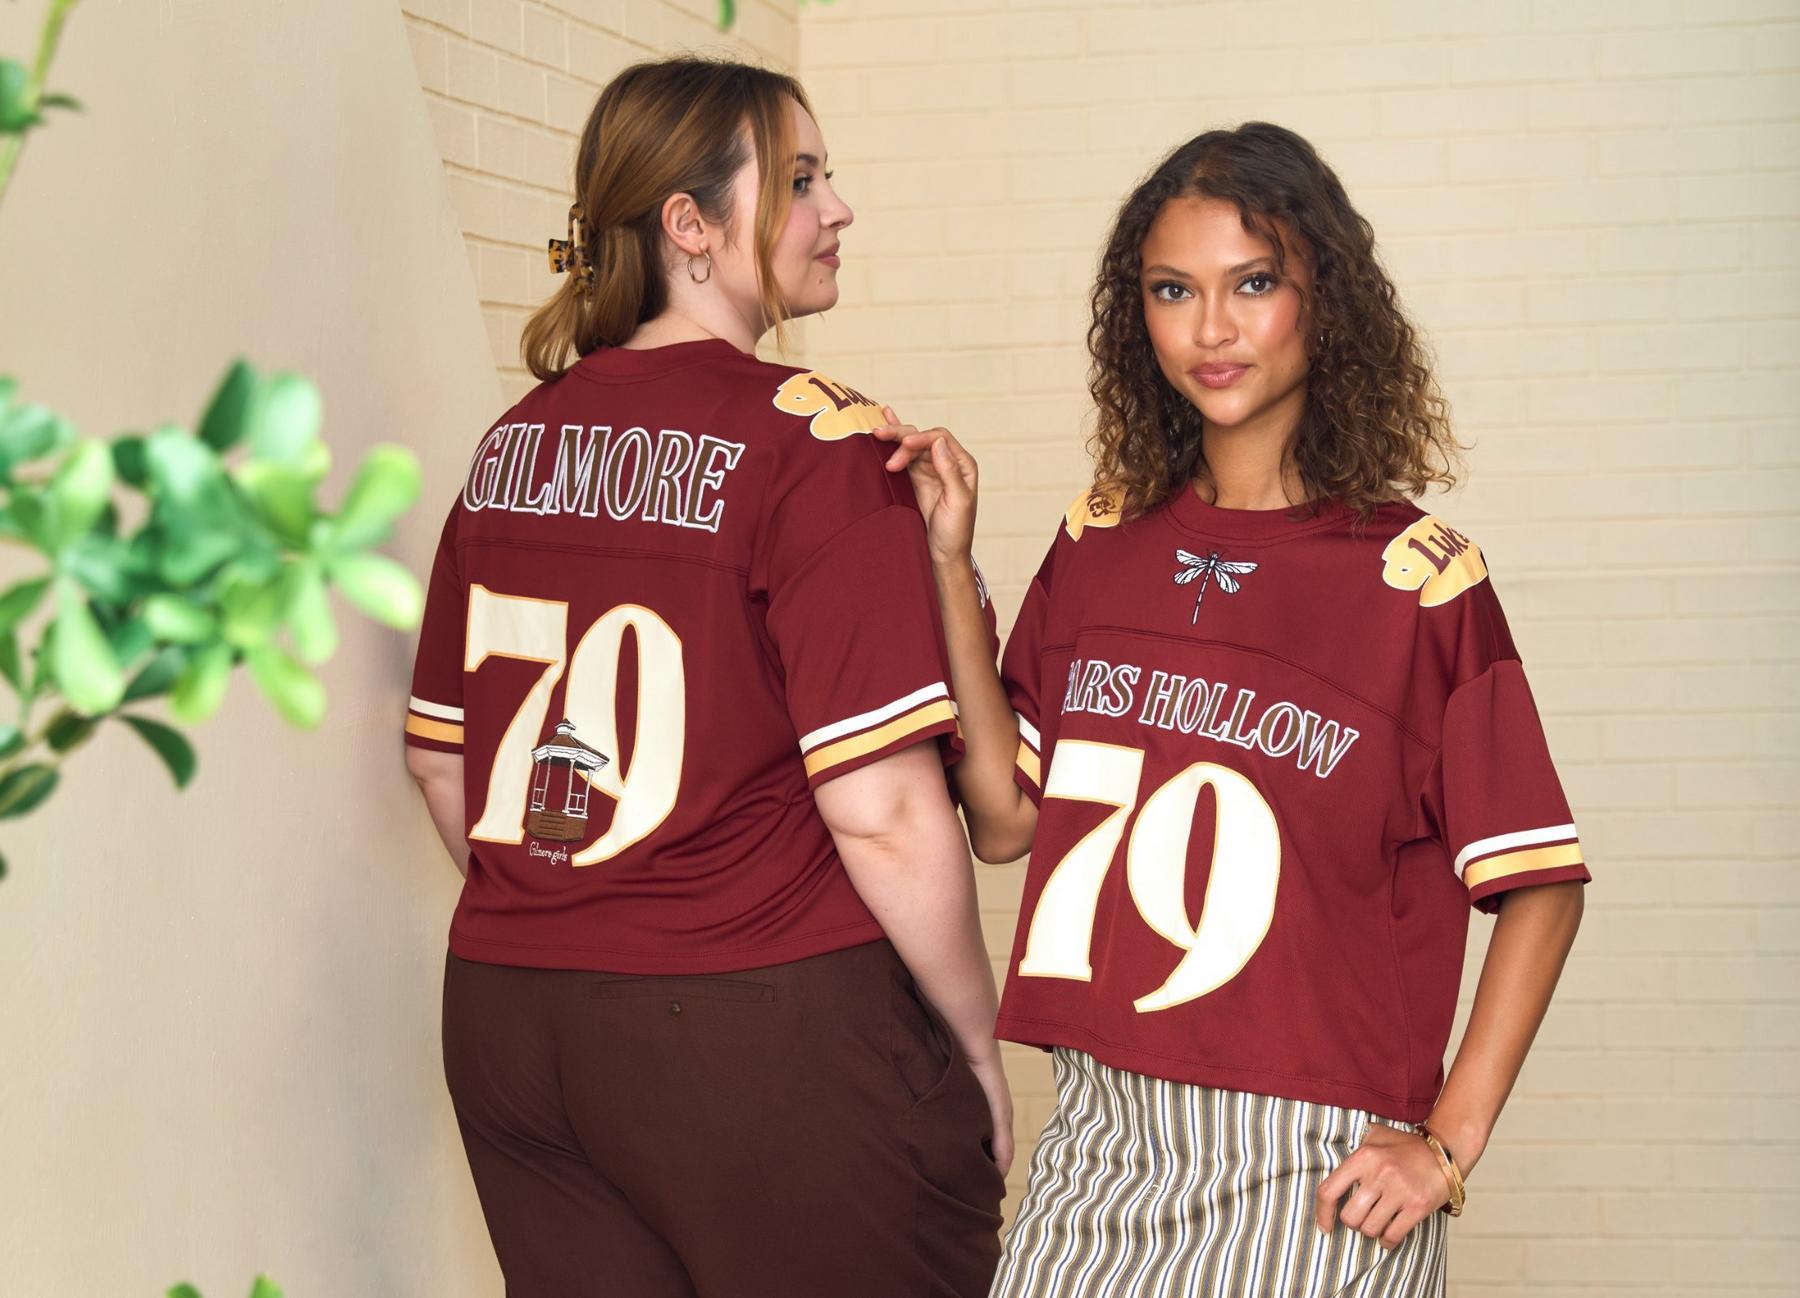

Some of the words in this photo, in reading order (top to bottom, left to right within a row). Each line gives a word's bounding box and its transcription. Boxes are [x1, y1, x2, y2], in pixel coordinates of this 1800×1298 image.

[463, 423, 746, 533] GILMORE
[464, 583, 686, 867] 79
[1061, 659, 1142, 717] ARS
[1138, 670, 1360, 778] HOLLOW
[1018, 738, 1282, 1014] 79
